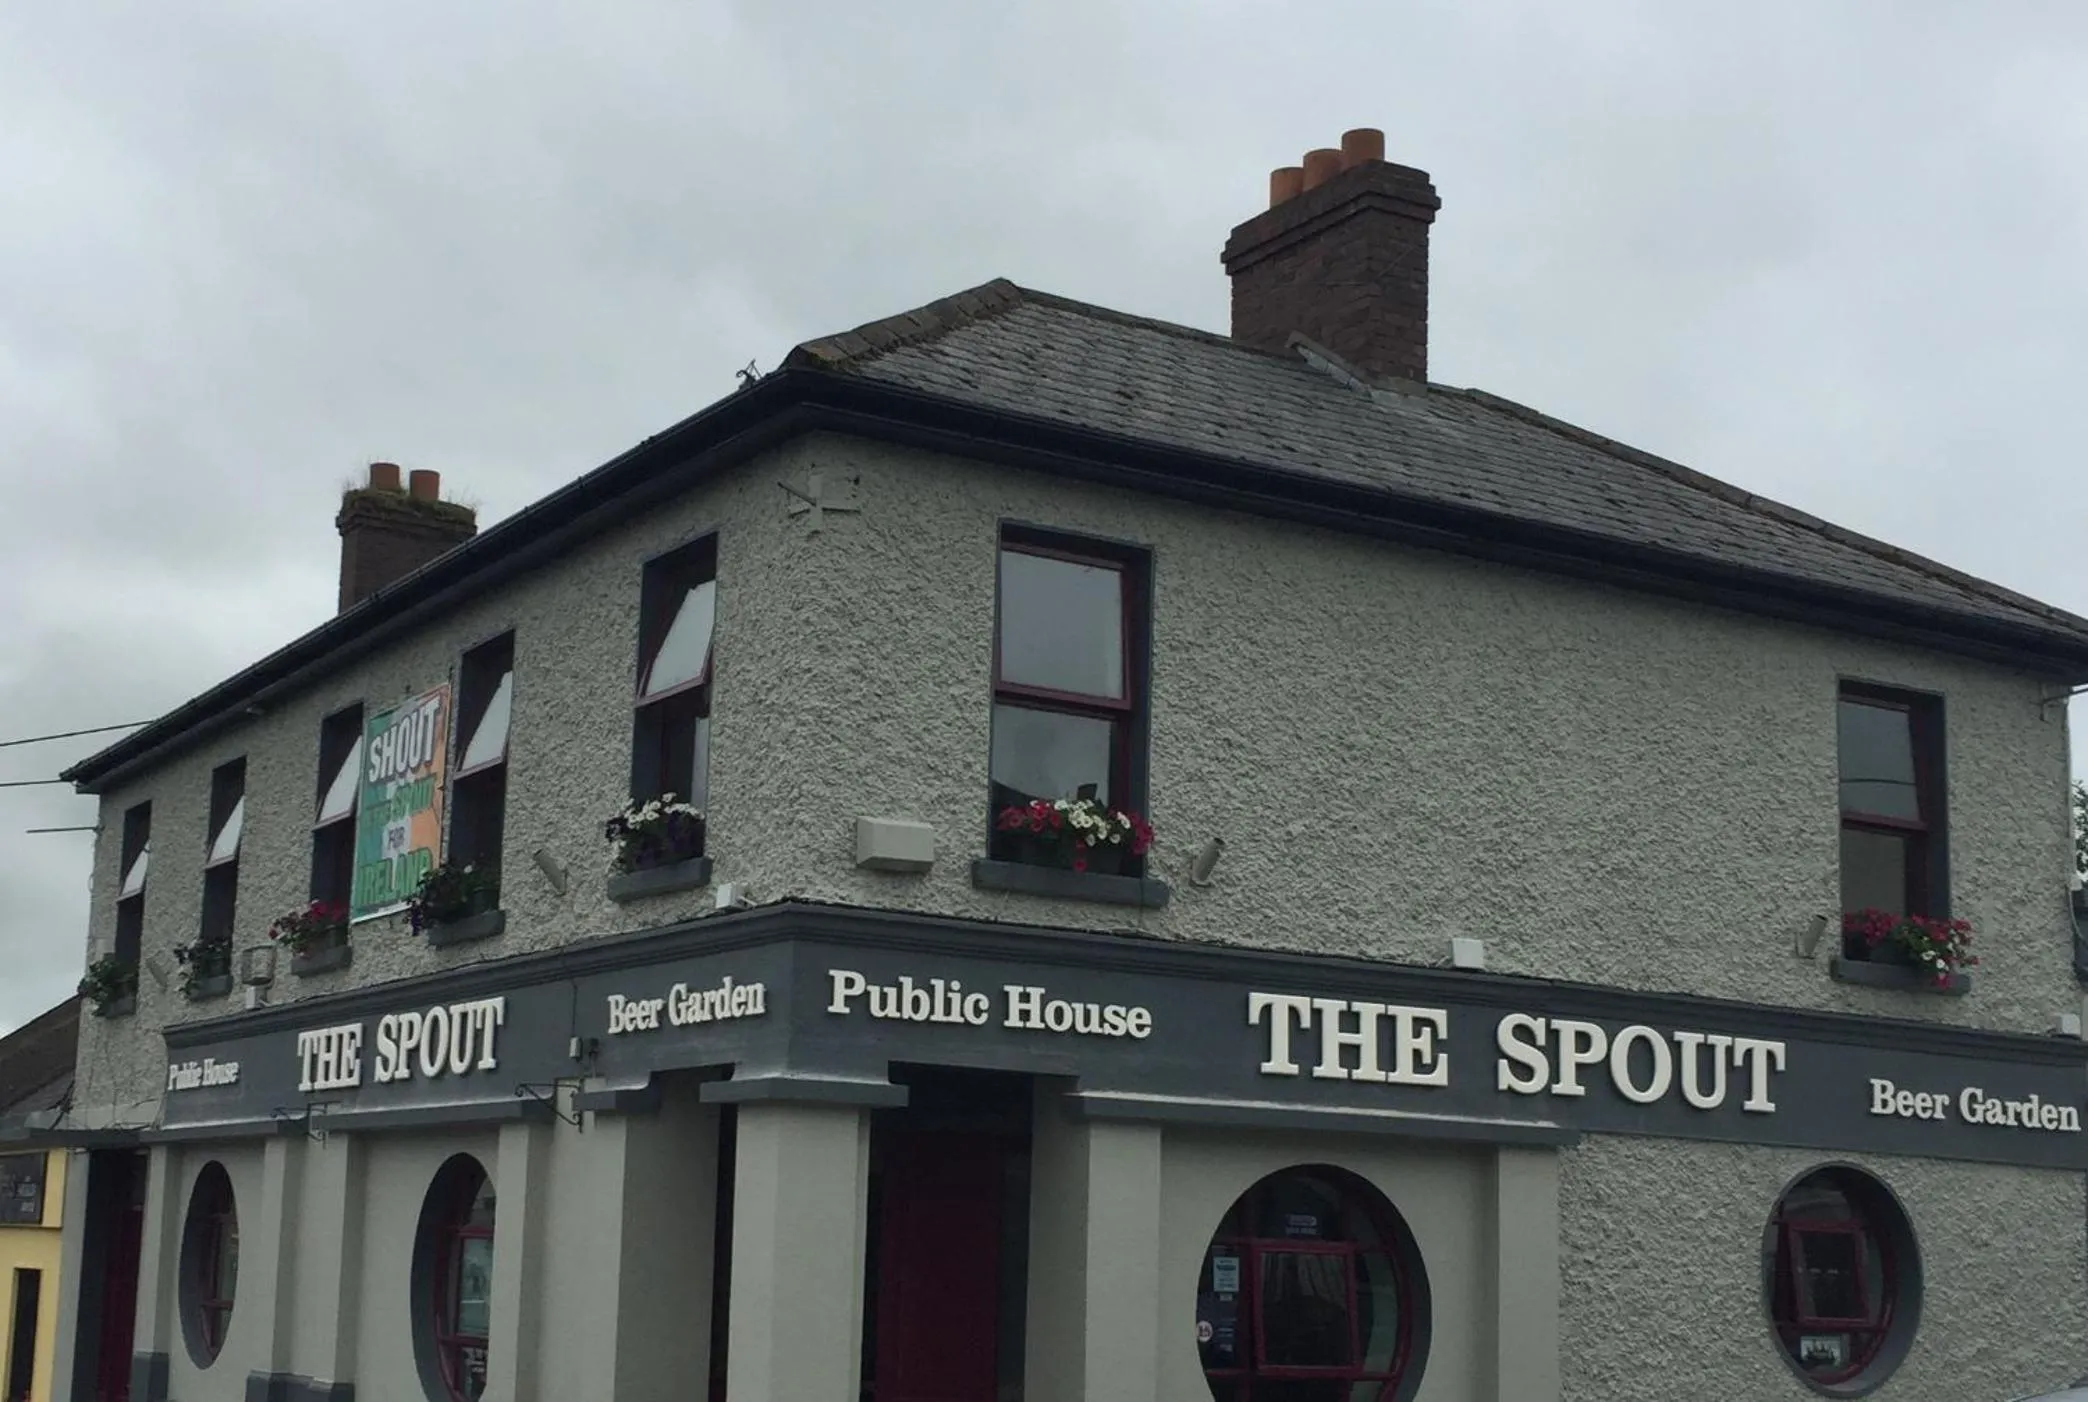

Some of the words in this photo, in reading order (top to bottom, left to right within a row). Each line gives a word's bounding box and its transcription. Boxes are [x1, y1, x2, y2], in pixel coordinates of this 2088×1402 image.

[368, 695, 440, 782] SHOUT
[387, 826, 406, 852] FOR
[606, 993, 664, 1035] Beer
[668, 976, 767, 1027] Garden
[829, 968, 991, 1026] Public
[1002, 983, 1153, 1039] House
[167, 1060, 202, 1091] Public
[201, 1058, 240, 1086] House
[297, 1022, 364, 1092] THE
[373, 997, 506, 1083] SPOUT
[1248, 991, 1450, 1087] THE
[1497, 1013, 1787, 1113] SPOUT
[1869, 1077, 1951, 1121] Beer
[1959, 1087, 2083, 1133] Garden
